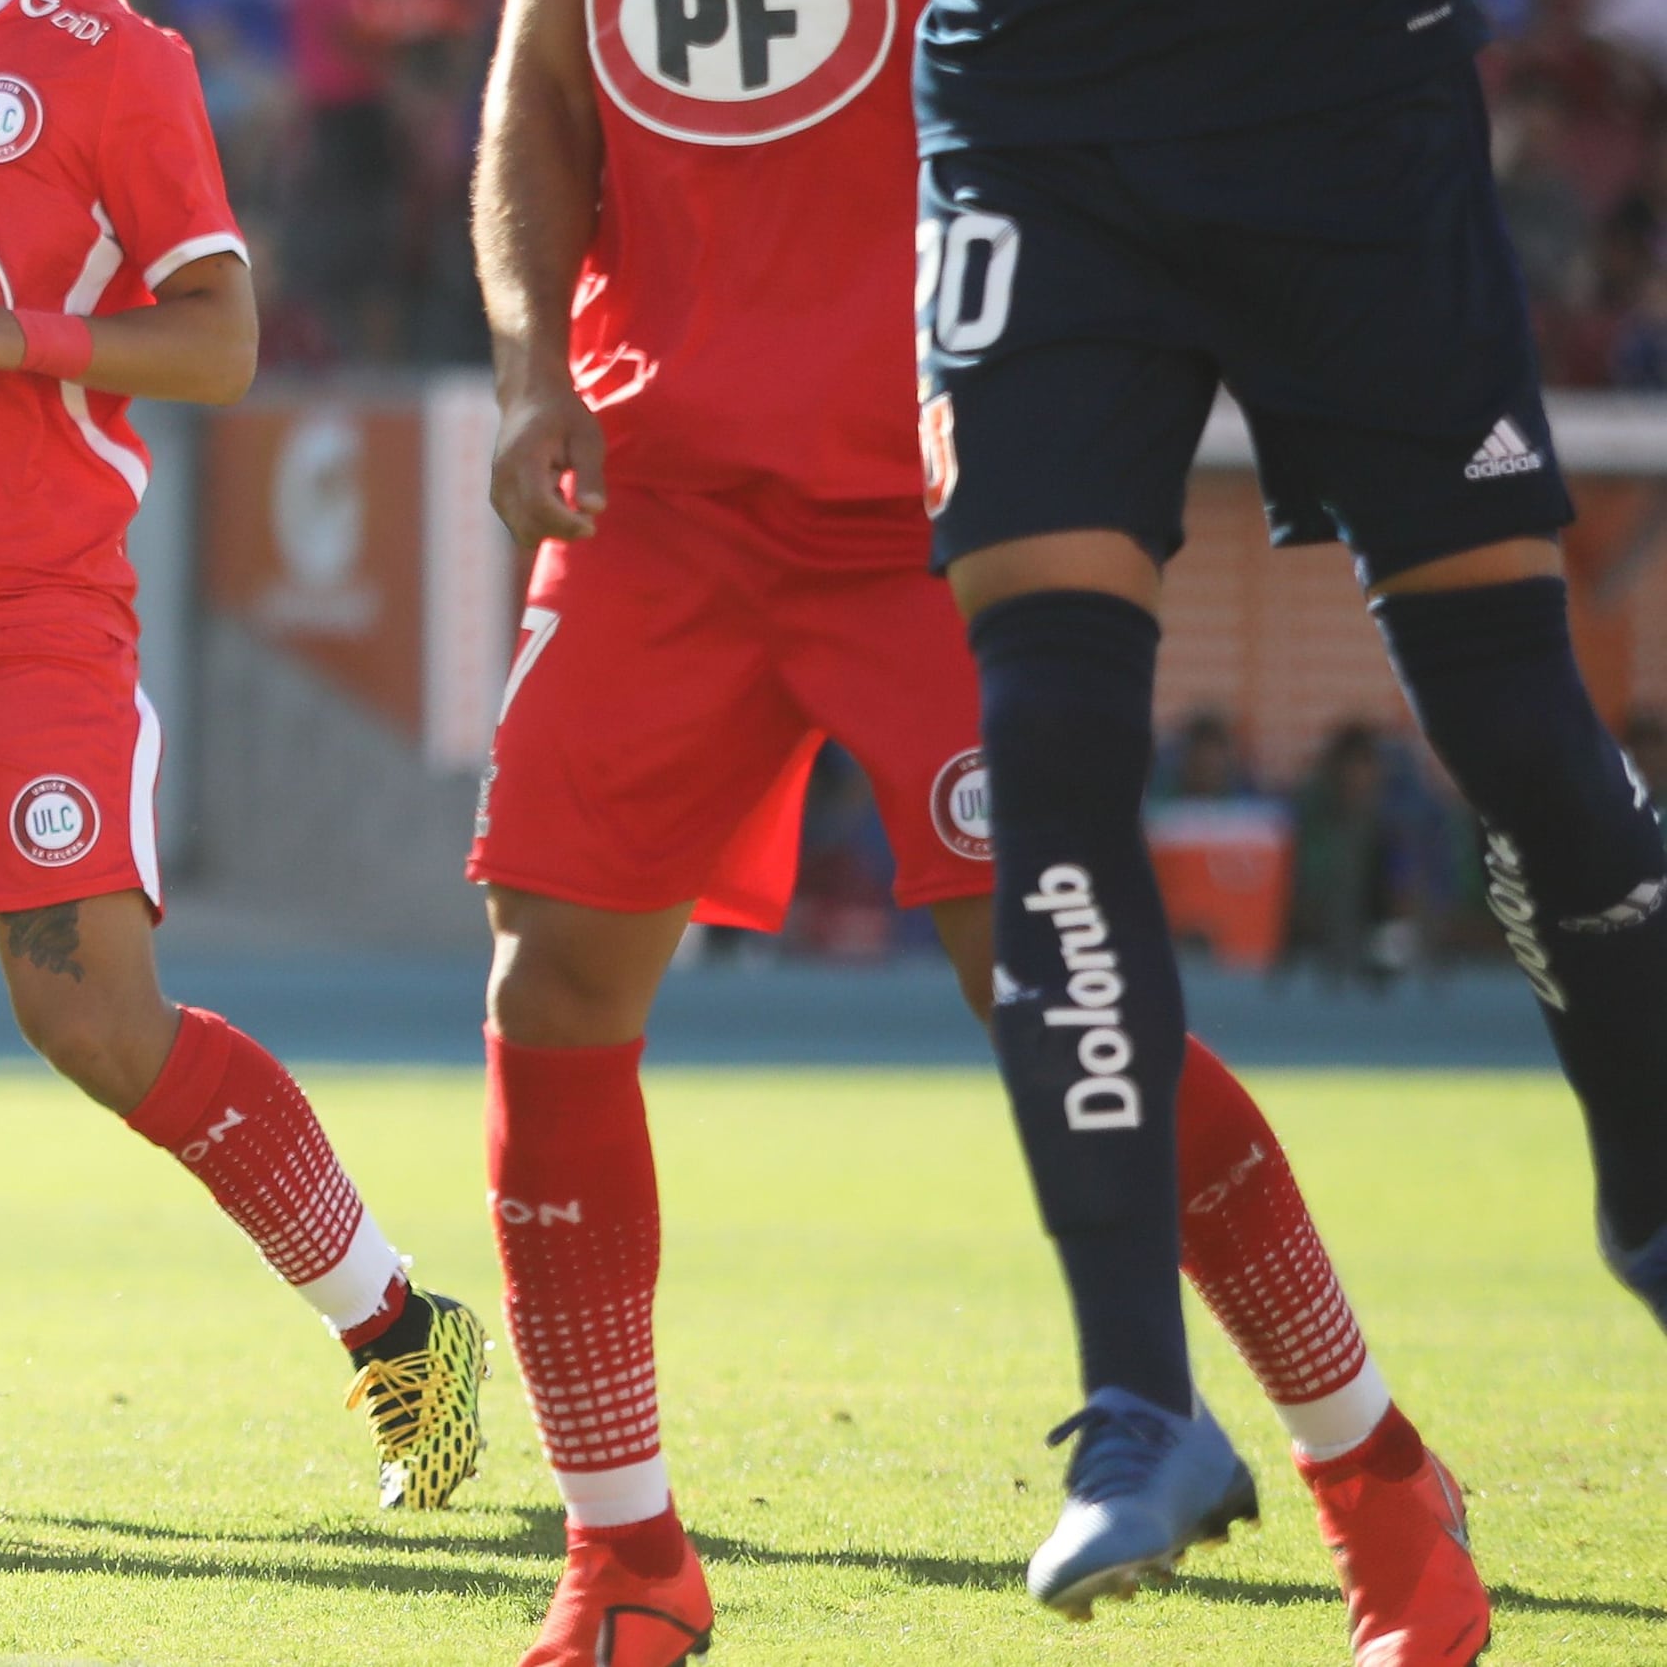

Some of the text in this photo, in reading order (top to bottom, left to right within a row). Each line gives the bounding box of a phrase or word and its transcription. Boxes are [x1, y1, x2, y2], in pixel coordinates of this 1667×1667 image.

[1464, 452, 1542, 479] adidas
[32, 803, 75, 837] ULC
[958, 788, 991, 822] UL
[1021, 860, 1143, 1131] Dolorub
